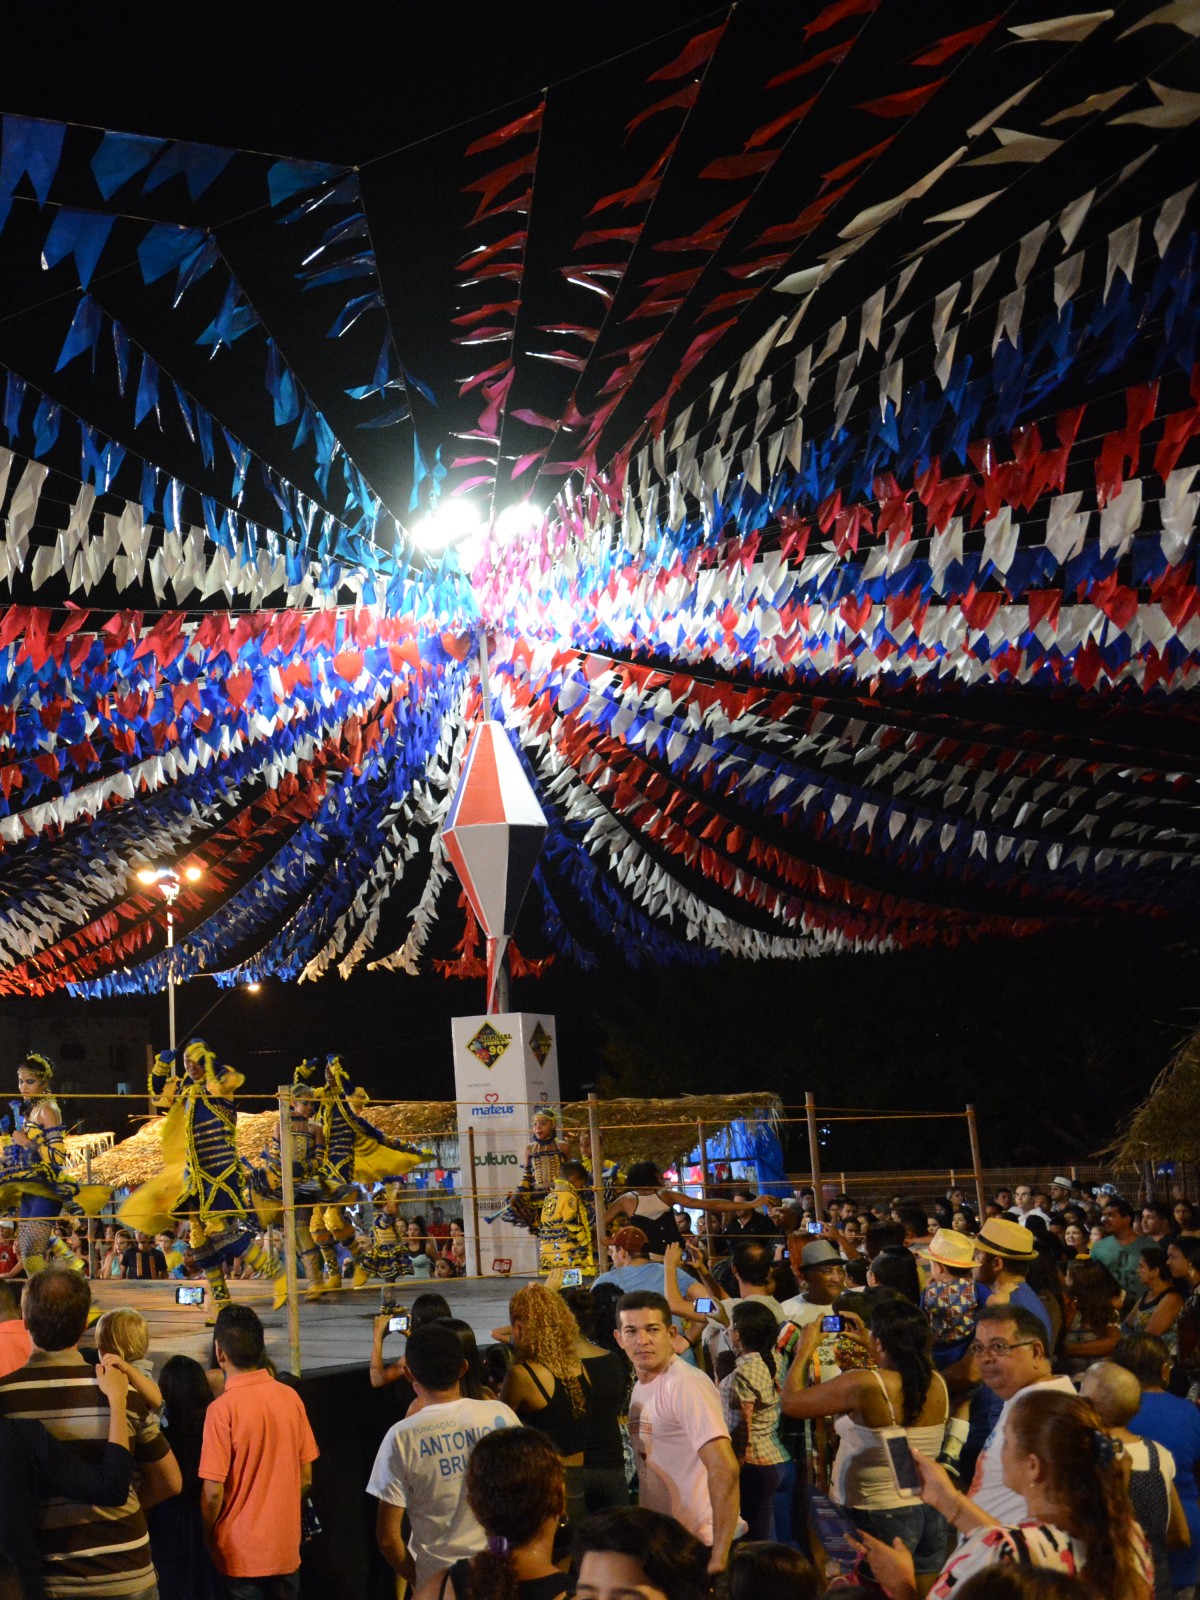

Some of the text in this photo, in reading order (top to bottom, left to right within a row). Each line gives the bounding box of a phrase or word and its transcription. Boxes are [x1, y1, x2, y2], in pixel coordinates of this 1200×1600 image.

[489, 1045, 504, 1055] 90
[472, 1105, 514, 1116] mateus
[494, 1261, 510, 1272] Biju
[413, 1420, 456, 1435] FUNDAÇÃO
